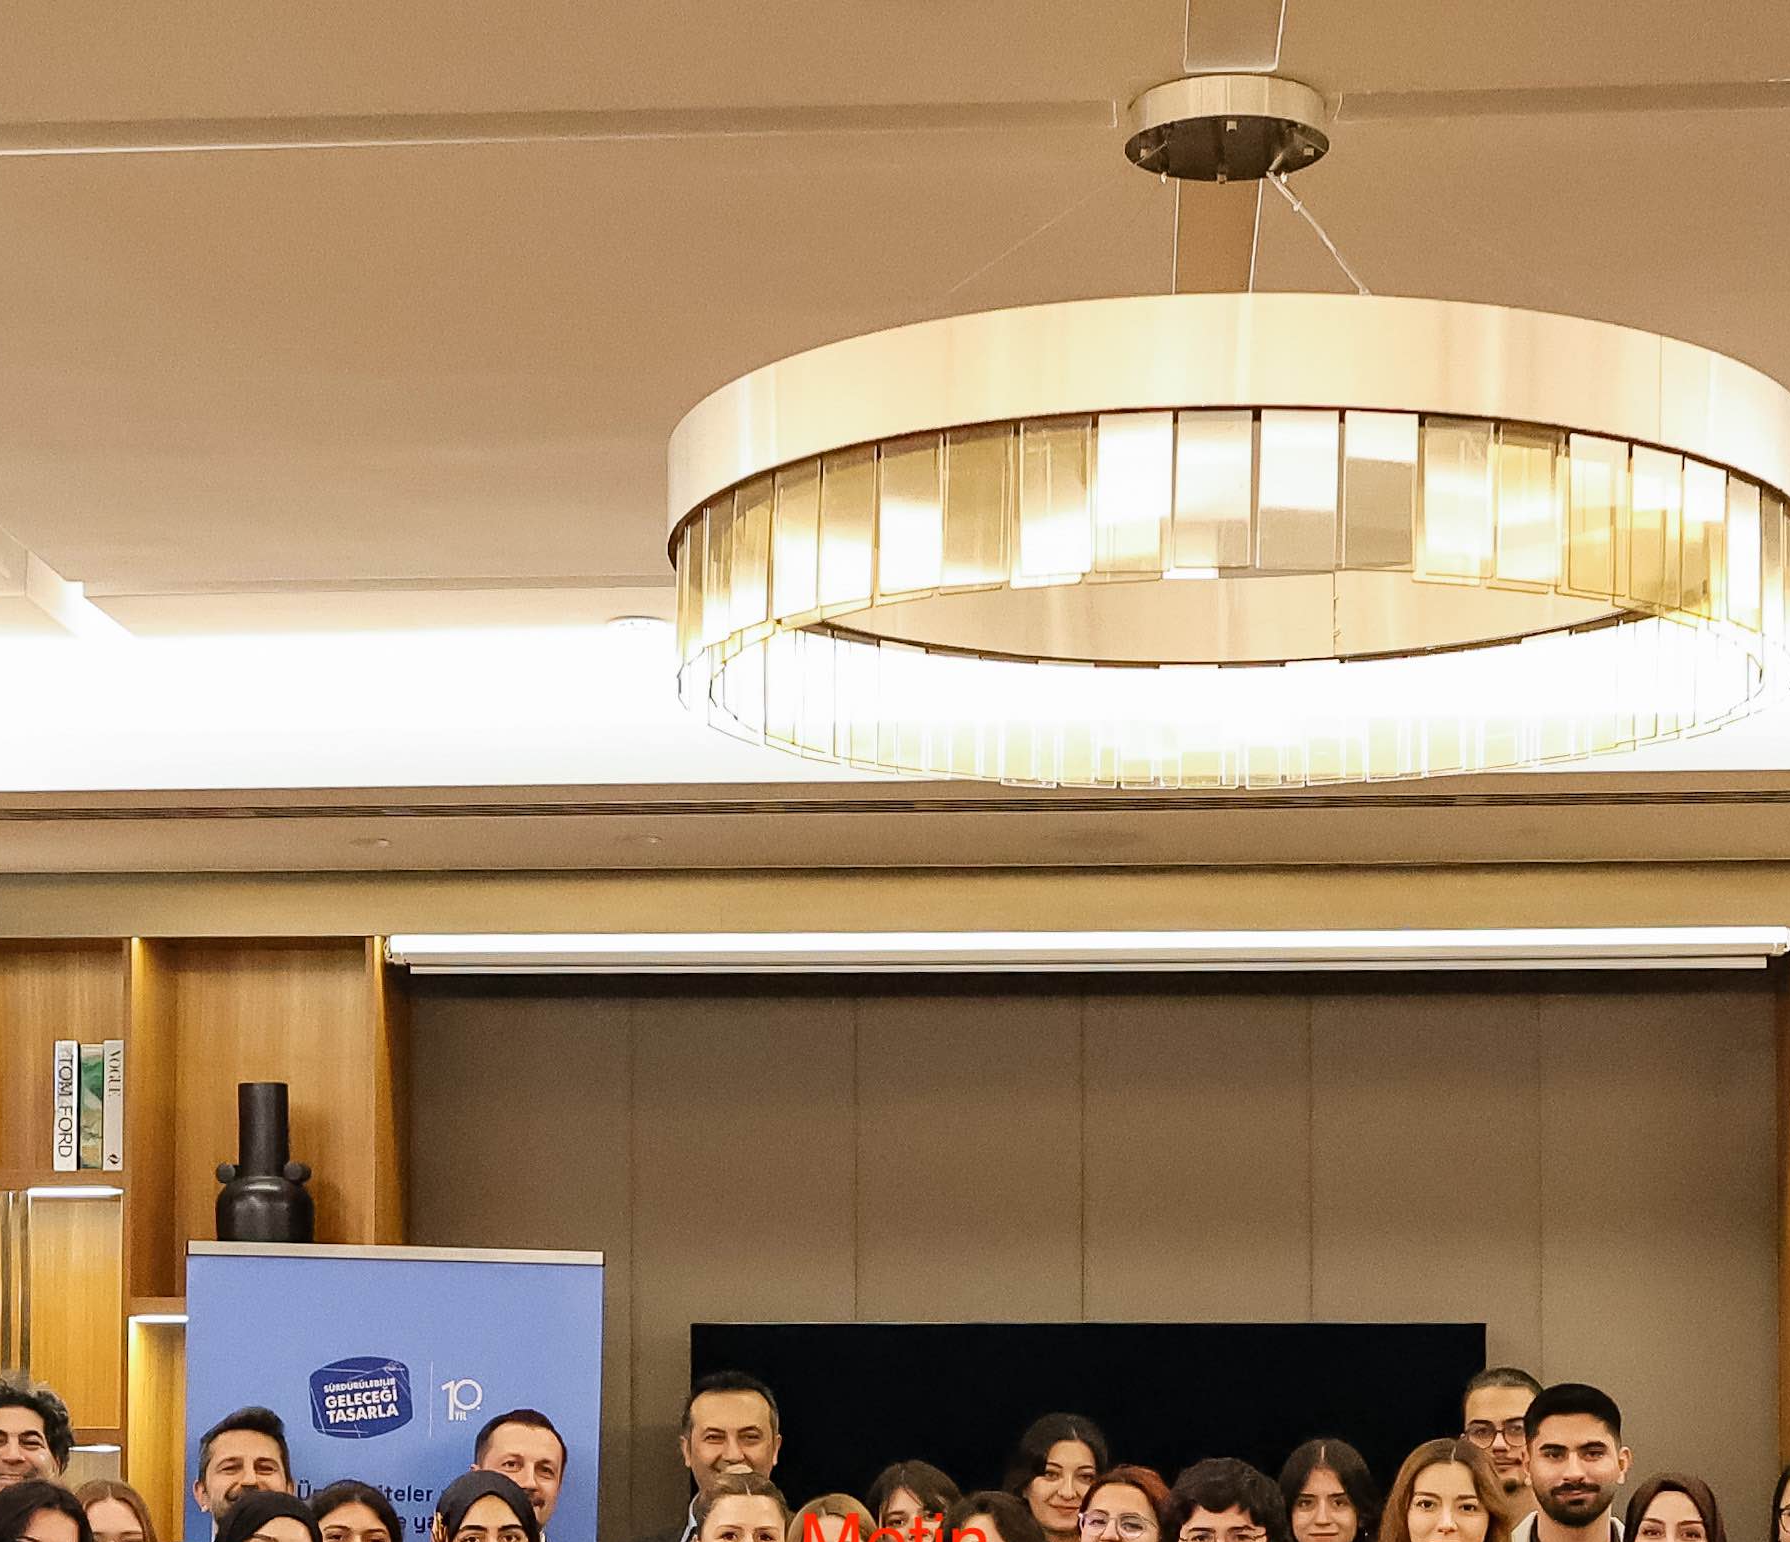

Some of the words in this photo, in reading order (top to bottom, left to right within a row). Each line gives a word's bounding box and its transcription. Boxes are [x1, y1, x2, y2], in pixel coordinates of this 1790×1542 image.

[58, 1054, 72, 1097] TOM
[108, 1050, 121, 1097] VOGUE
[58, 1105, 73, 1157] FORD
[324, 1387, 398, 1408] GELECEĞİ
[325, 1405, 399, 1424] TASARLA
